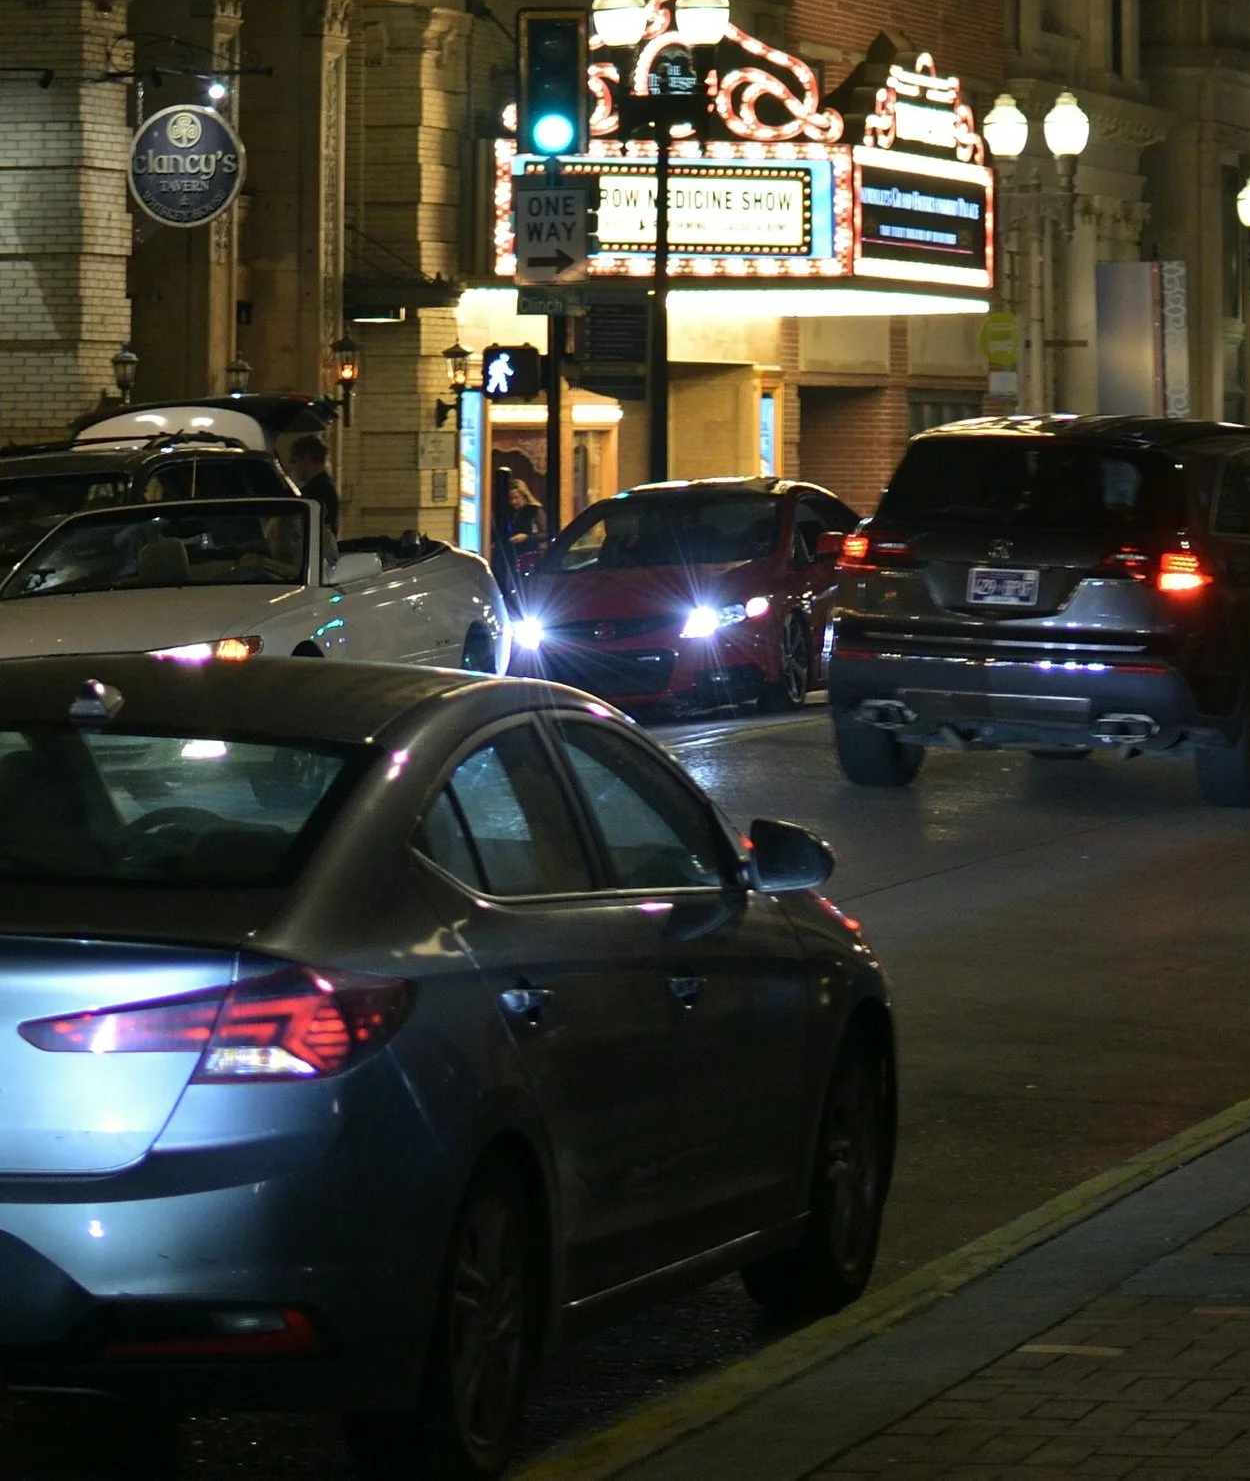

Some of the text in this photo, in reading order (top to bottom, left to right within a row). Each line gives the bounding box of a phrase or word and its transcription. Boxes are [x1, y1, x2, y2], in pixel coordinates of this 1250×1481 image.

[133, 149, 237, 180] clancy's
[158, 180, 210, 192] TAVERN
[527, 196, 576, 216] ONE
[742, 191, 793, 211] SHOW
[525, 221, 577, 242] WAY
